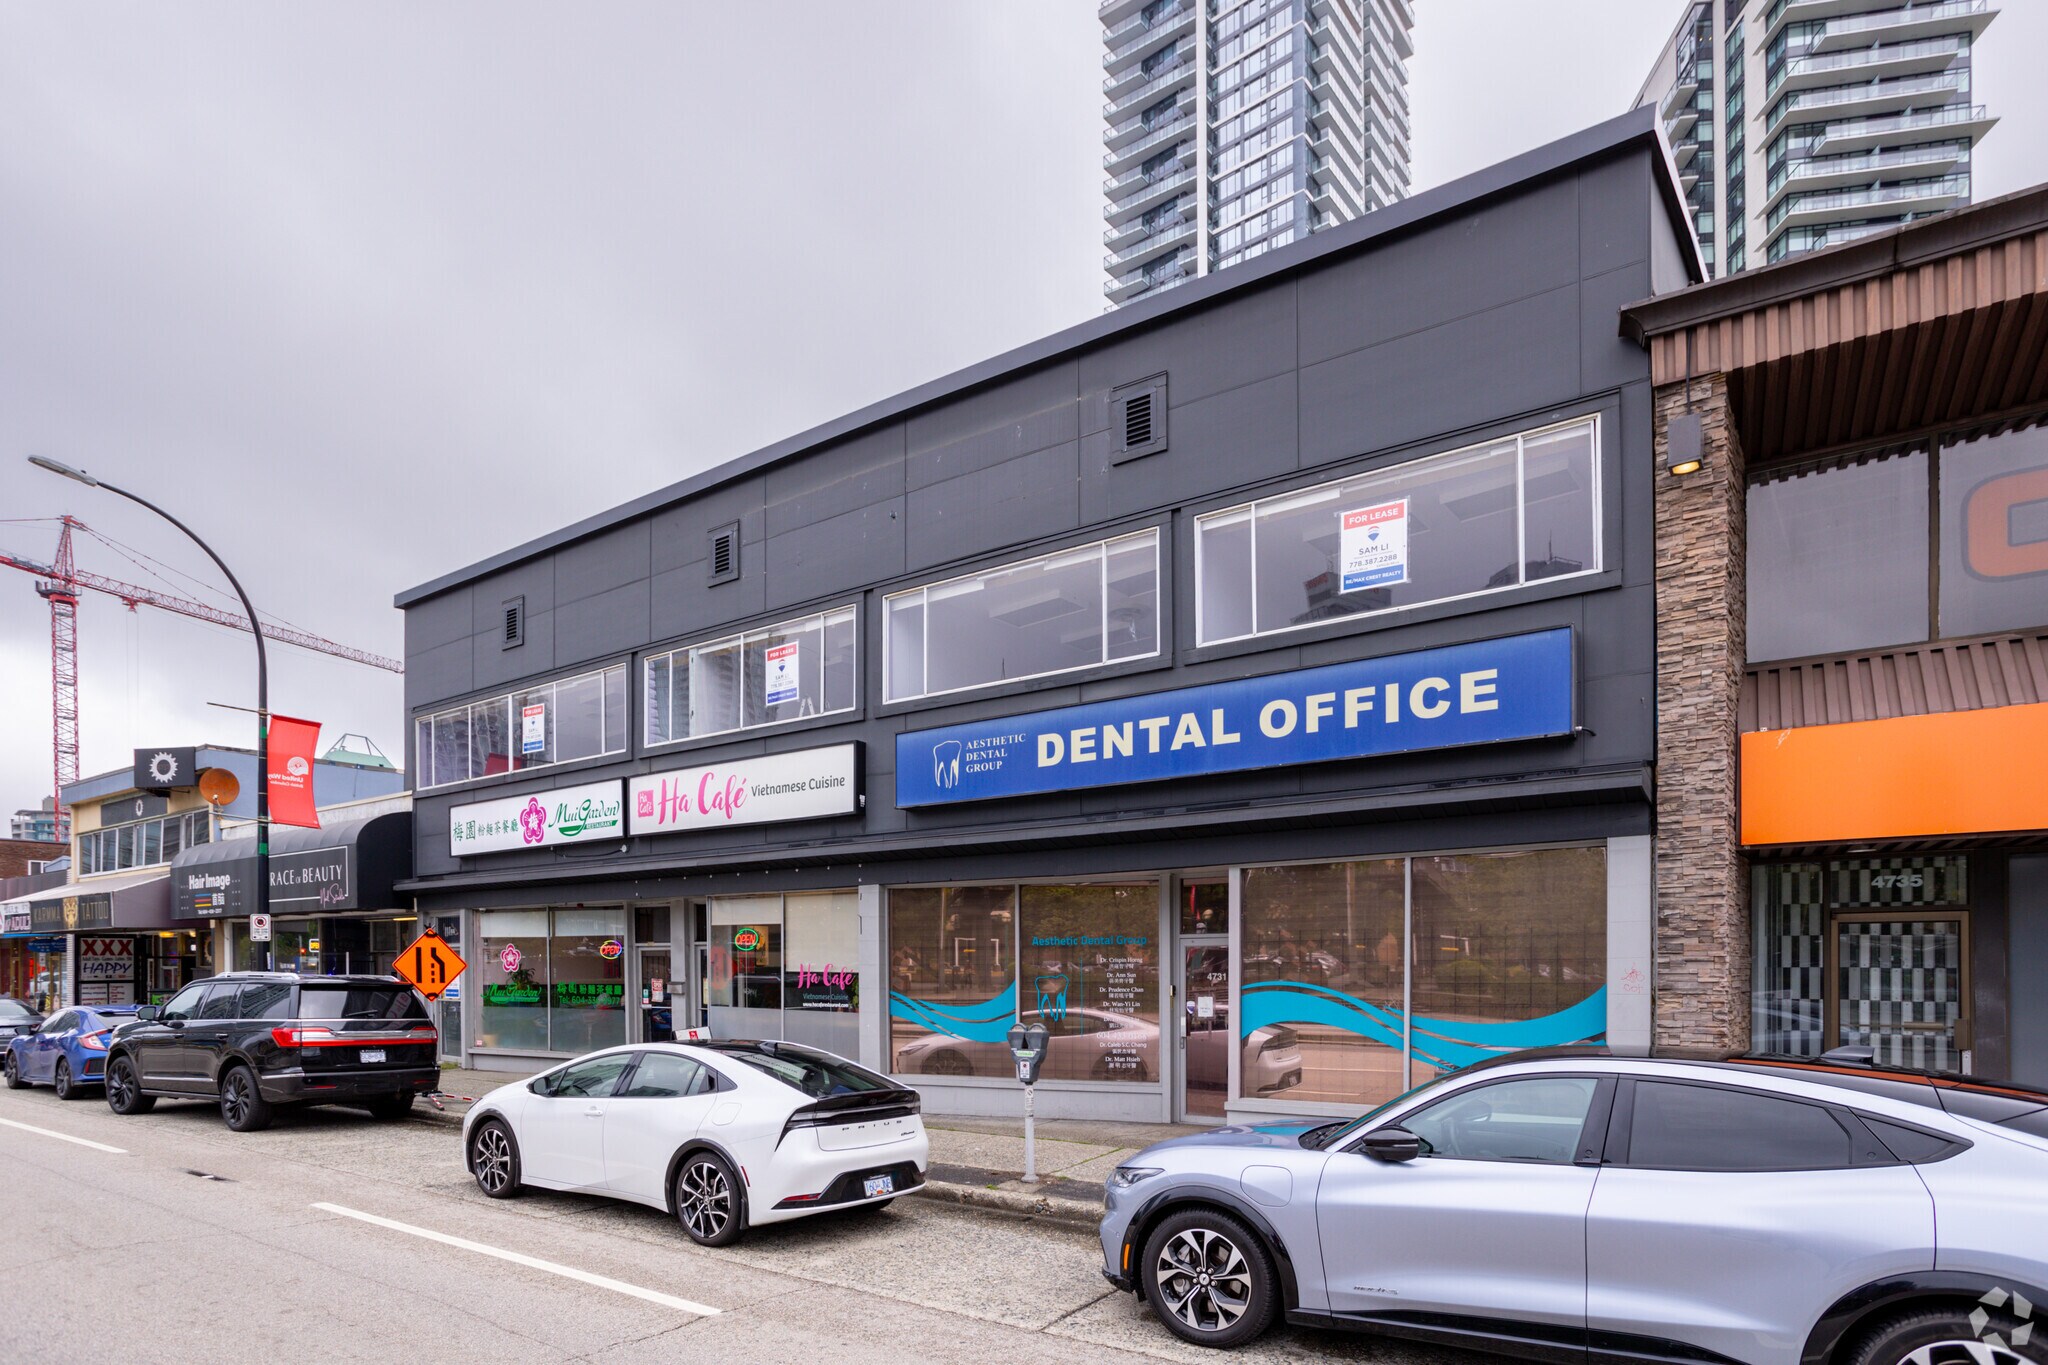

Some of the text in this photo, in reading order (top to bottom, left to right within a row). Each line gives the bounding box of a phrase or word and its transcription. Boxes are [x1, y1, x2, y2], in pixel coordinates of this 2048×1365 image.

[1349, 508, 1398, 525] FOR LEASE
[1359, 545, 1378, 556] SAM
[1381, 543, 1389, 551] LI
[1349, 554, 1397, 569] 778.387.2288
[1366, 573, 1381, 581] CREST
[1038, 668, 1499, 767] DENTAL OFFICE
[966, 733, 1026, 750] AESTHETIC
[966, 748, 1008, 762] DENTAL
[966, 760, 1003, 774] GROUP
[640, 793, 648, 802] Ha
[658, 772, 846, 825] Ha Café Vietnamese Cuisine
[188, 873, 231, 890] Hair Image
[270, 869, 295, 886] RACE
[302, 864, 343, 883] BEAUTY
[1871, 874, 1924, 888] 4735
[736, 934, 756, 945] OPEN
[1032, 935, 1147, 946] Aesthetic Dental Group
[82, 939, 133, 956] XXX
[601, 945, 620, 955] OPEN
[83, 962, 132, 974] HAPPY
[798, 963, 856, 990] Ha Café
[1207, 972, 1227, 981] 4731
